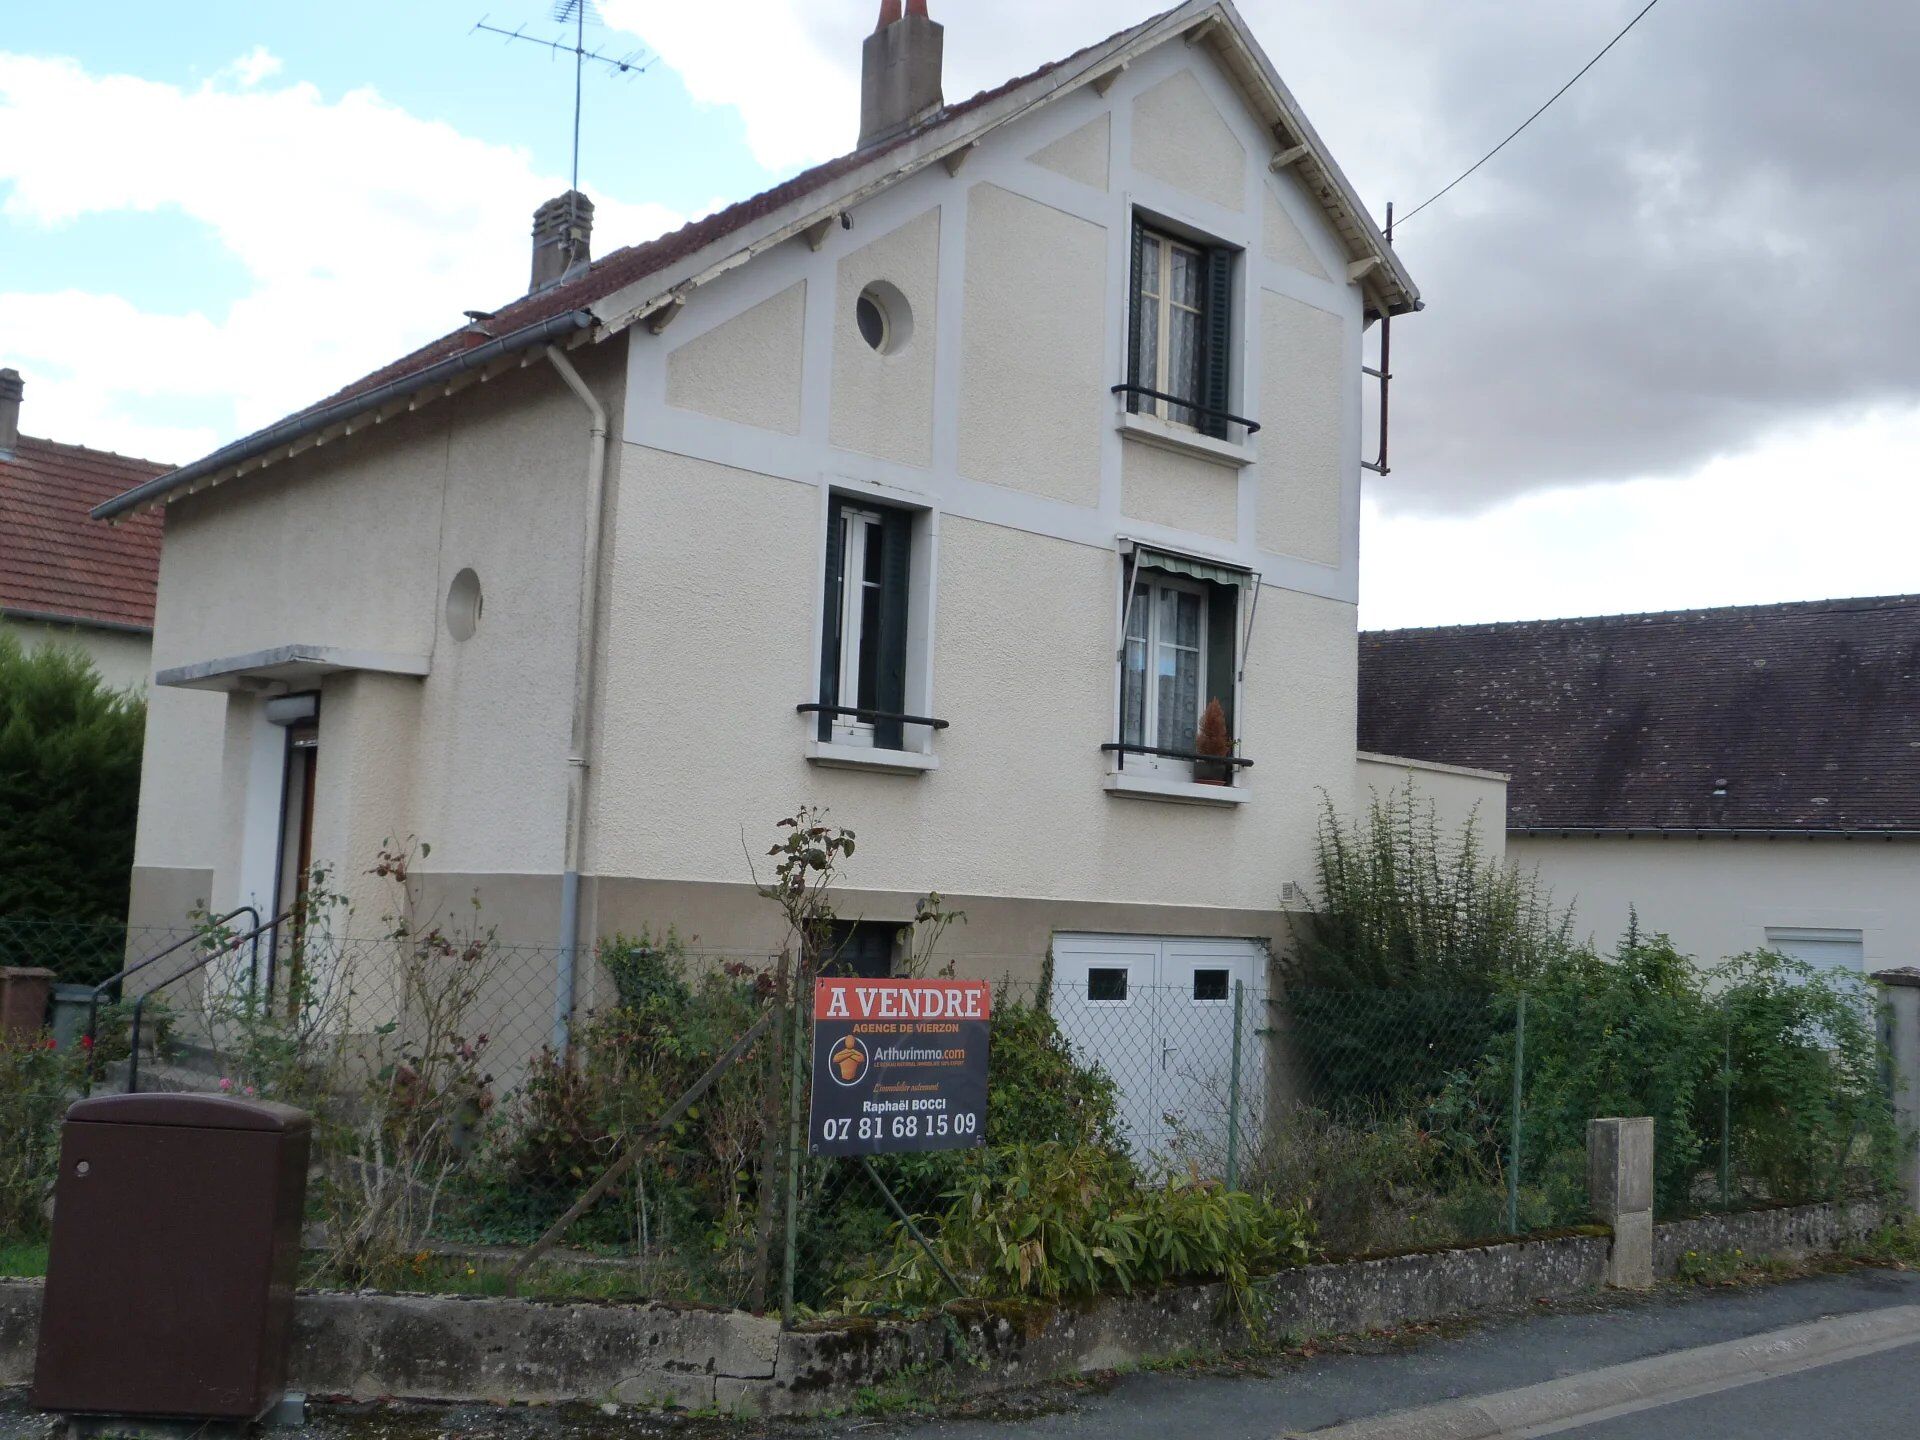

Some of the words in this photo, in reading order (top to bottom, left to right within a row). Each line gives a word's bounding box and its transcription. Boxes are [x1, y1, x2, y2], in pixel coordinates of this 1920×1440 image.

[827, 988, 849, 1017] A
[855, 988, 981, 1017] VENDRE
[853, 1023, 896, 1033] AGENCE
[899, 1023, 913, 1033] DE
[916, 1023, 959, 1033] VIERZON
[874, 1047, 965, 1061] Arthurimmo.com
[863, 1100, 909, 1114] Raphaël
[912, 1098, 946, 1110] BOCCI
[823, 1118, 852, 1140] 07
[858, 1117, 883, 1139] 81
[892, 1116, 917, 1137] 68
[925, 1114, 948, 1136] 15
[954, 1113, 976, 1134] 09
